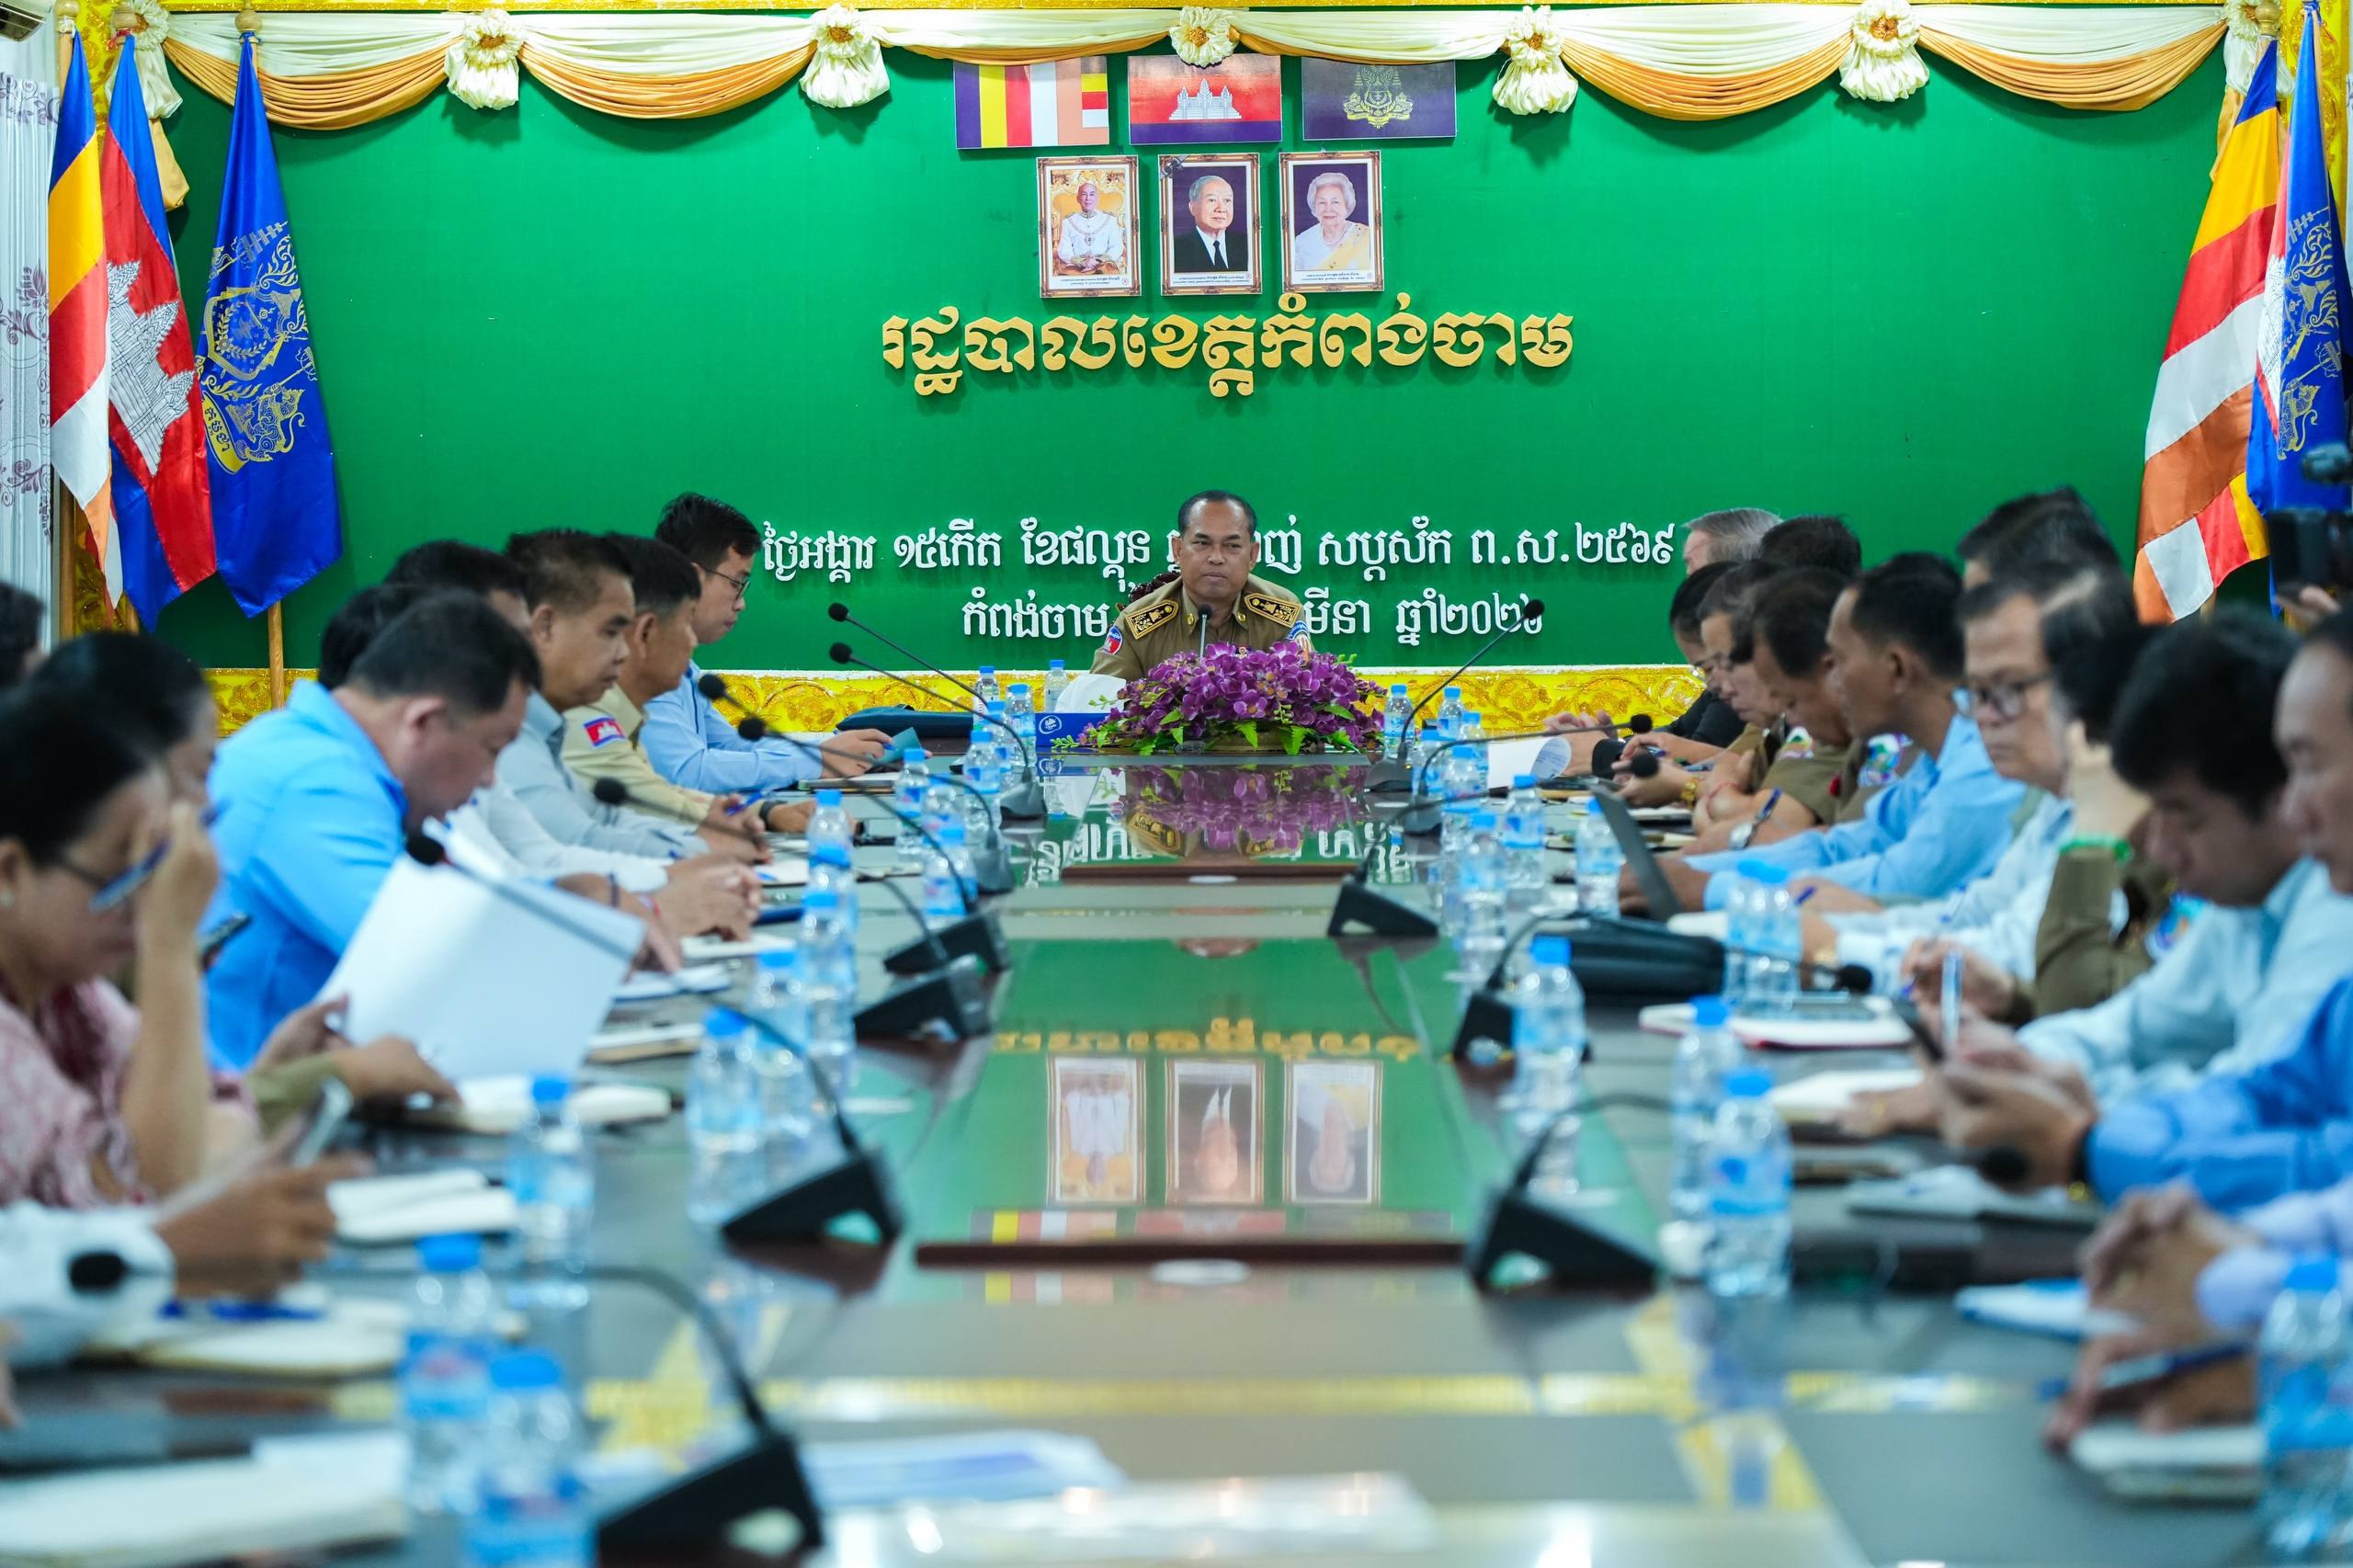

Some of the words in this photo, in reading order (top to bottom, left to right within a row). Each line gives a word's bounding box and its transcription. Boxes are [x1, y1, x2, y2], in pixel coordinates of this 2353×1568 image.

[882, 292, 1573, 397] រដ្ឋបាលខេត្តកំពង់ចាម
[763, 520, 877, 584] ថ្ងៃអង្គារ
[893, 517, 1002, 569] ១៥កើត
[1020, 517, 1151, 593] ខែផល្គុន
[962, 585, 1110, 639] កំពង់ចាម
